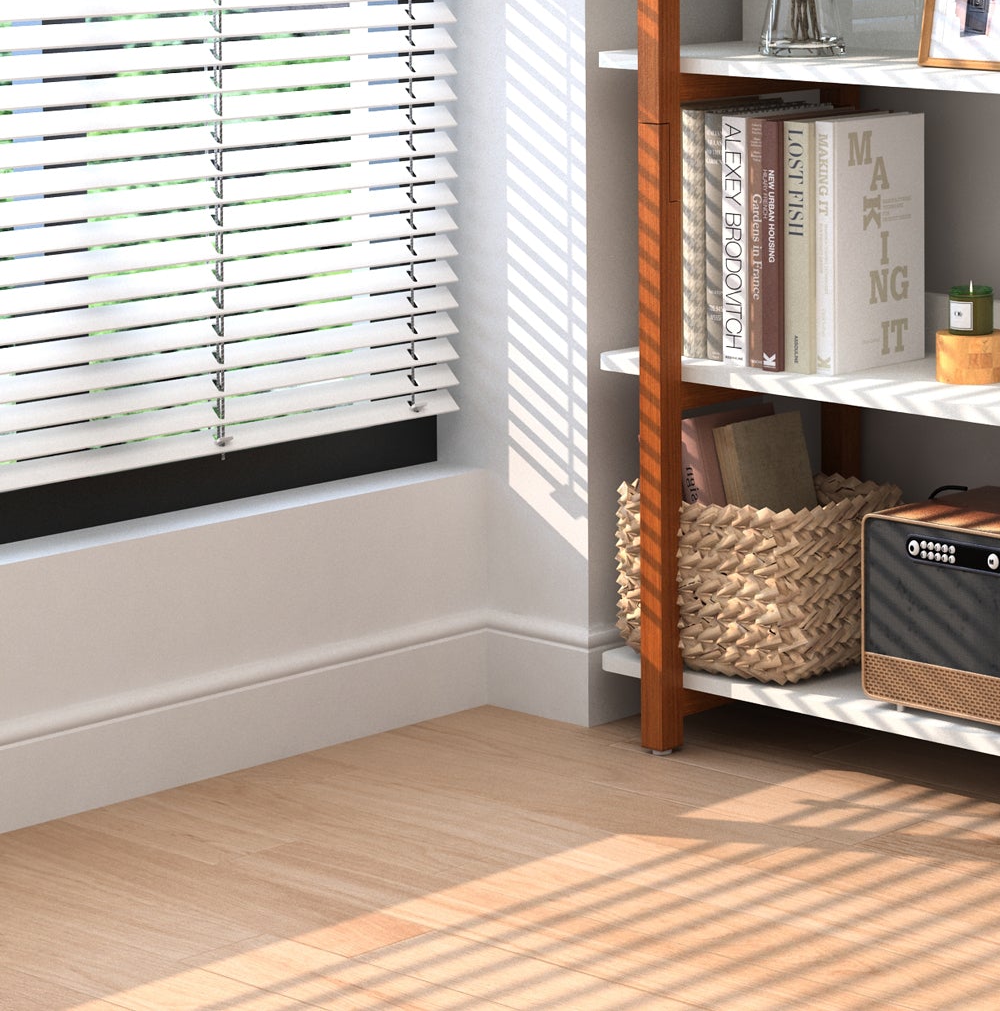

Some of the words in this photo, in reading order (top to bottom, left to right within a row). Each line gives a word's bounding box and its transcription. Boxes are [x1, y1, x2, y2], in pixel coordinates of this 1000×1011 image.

[724, 122, 742, 206] ALEXEY
[788, 129, 804, 185] LOST
[818, 133, 829, 197] MAKING
[752, 193, 763, 242] Gardens
[788, 190, 804, 237] FISH
[818, 199, 829, 217] IT
[752, 246, 763, 257] in
[768, 223, 776, 263] HOUSING
[724, 212, 743, 350] BRODOVITCH
[752, 261, 763, 301] France
